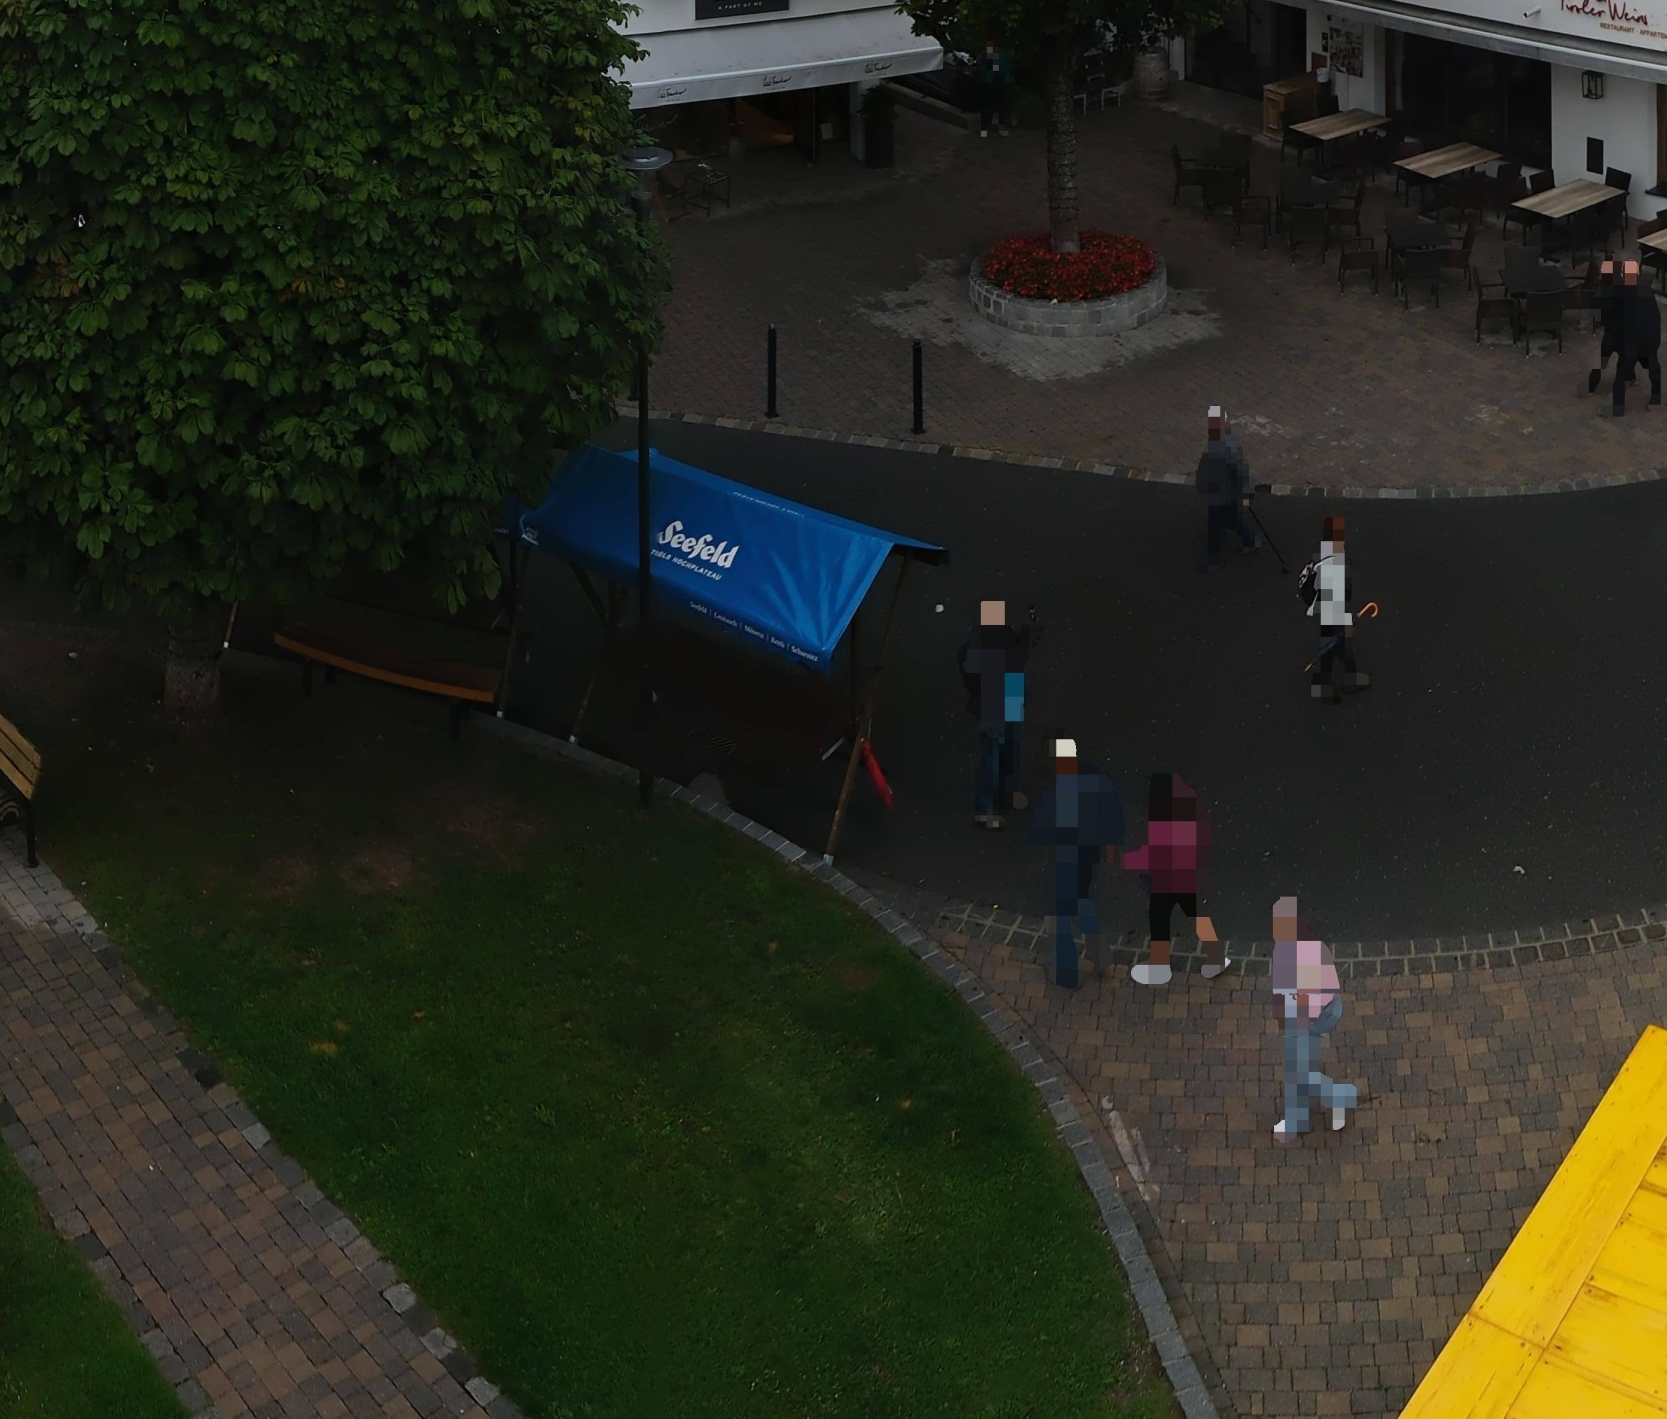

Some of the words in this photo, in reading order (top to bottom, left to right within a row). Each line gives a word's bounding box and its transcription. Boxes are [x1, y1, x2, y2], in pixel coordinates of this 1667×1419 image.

[1600, 23, 1635, 34] RESTAURANT
[659, 520, 741, 569] Seefeld
[672, 557, 722, 581] HOCHPLATEAU
